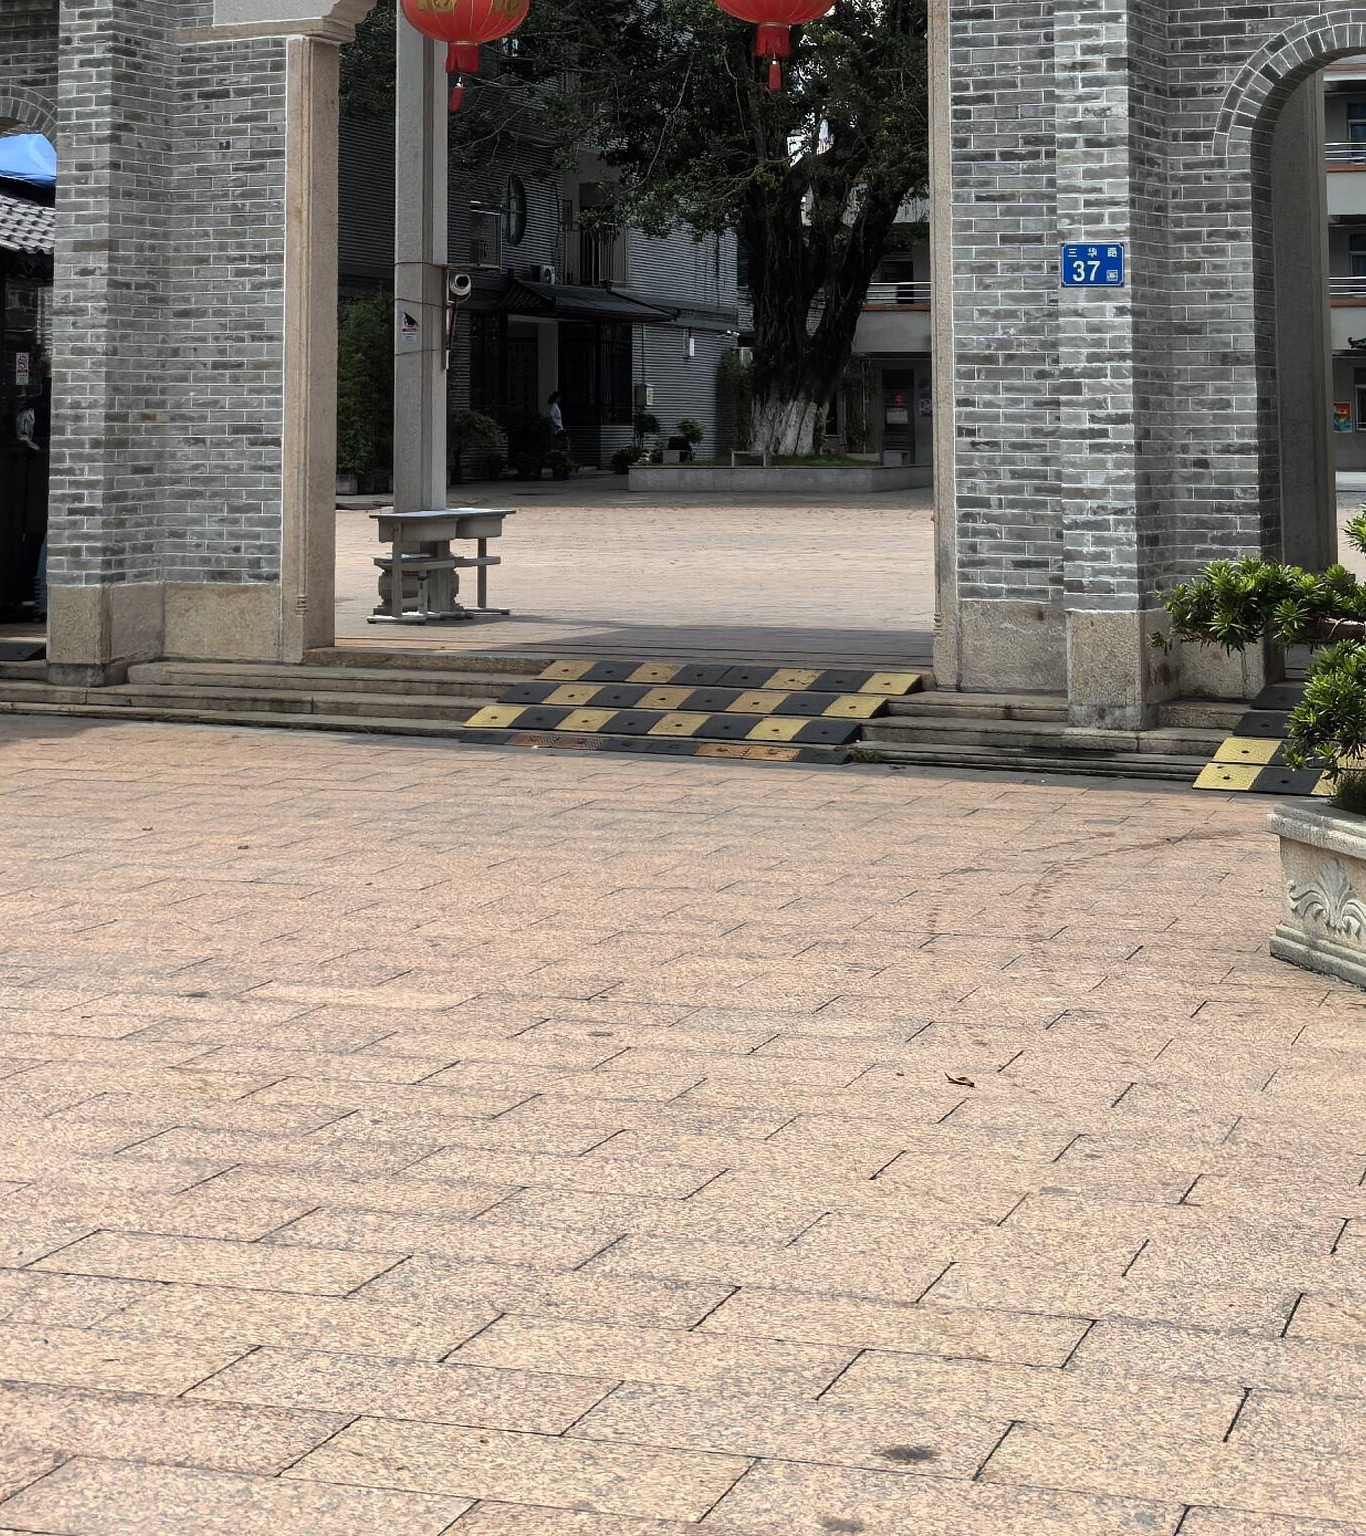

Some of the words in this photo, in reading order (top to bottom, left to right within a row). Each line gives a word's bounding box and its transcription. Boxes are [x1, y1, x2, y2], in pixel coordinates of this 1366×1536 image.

[1067, 247, 1118, 258] 三华路
[1072, 260, 1101, 282] 37
